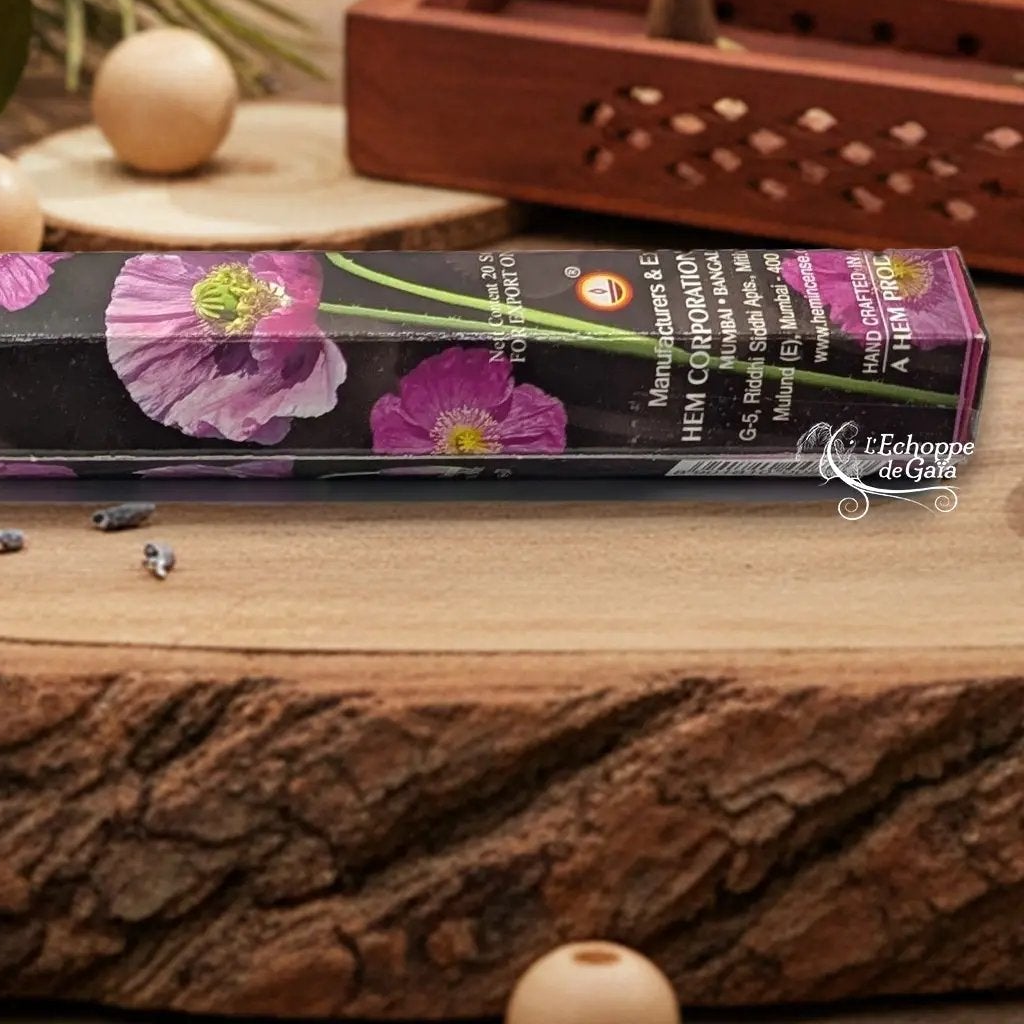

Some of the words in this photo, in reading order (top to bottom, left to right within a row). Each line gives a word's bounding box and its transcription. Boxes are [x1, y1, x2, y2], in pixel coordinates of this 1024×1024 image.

[481, 265, 497, 280] 20
[644, 268, 663, 280] &
[763, 252, 783, 274] 400
[501, 268, 526, 324] EXPORT
[676, 249, 712, 386] CORPORATION
[769, 284, 798, 330] Mumbai
[851, 271, 879, 326] CRAFTED
[509, 326, 527, 363] FOR
[647, 283, 675, 407] Manufacturers
[718, 307, 738, 370] MUMBAI
[749, 310, 767, 352] Siddhi
[888, 305, 912, 350] HEM
[862, 329, 882, 374] HAND
[890, 356, 911, 373] A
[743, 356, 766, 405] Riddhi
[773, 366, 795, 422] Mulund
[681, 391, 707, 442] HEM
[740, 406, 759, 441] G-5,
